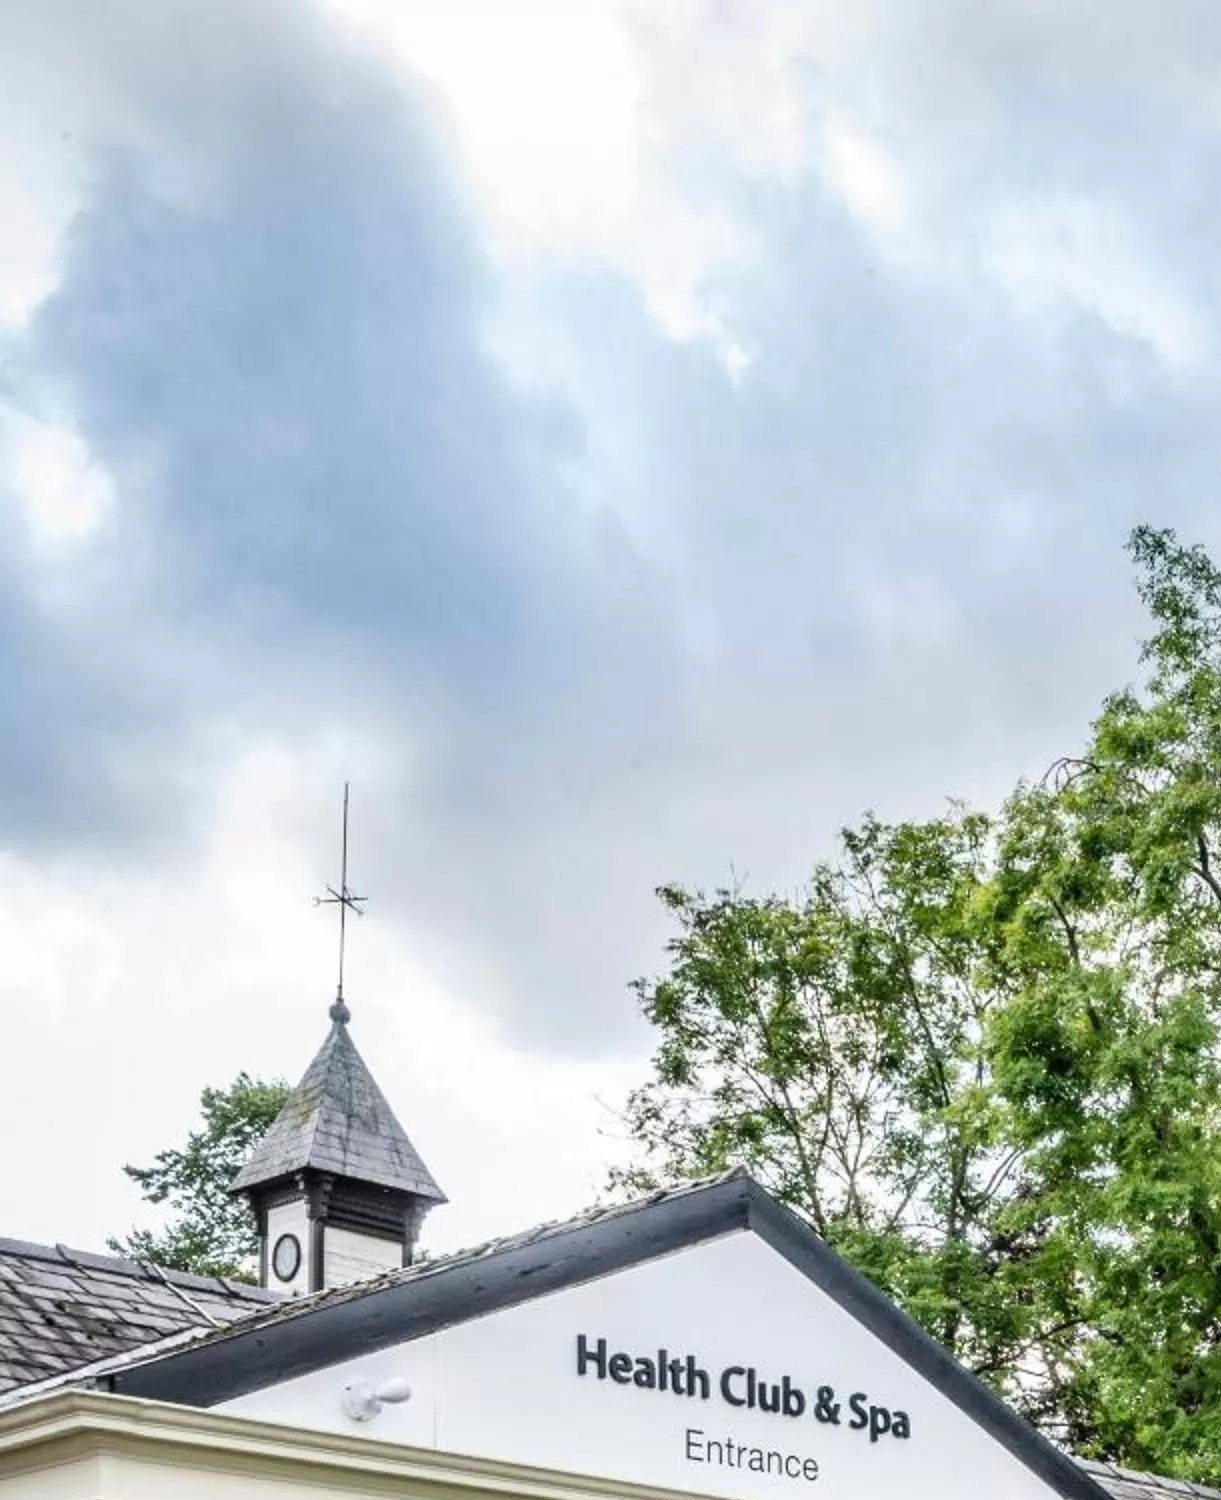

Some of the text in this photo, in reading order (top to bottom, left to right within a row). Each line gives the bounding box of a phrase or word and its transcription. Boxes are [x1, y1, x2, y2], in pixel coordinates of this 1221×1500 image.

[576, 1334, 911, 1444] Health Club & Spa
[686, 1428, 819, 1481] Entrance
